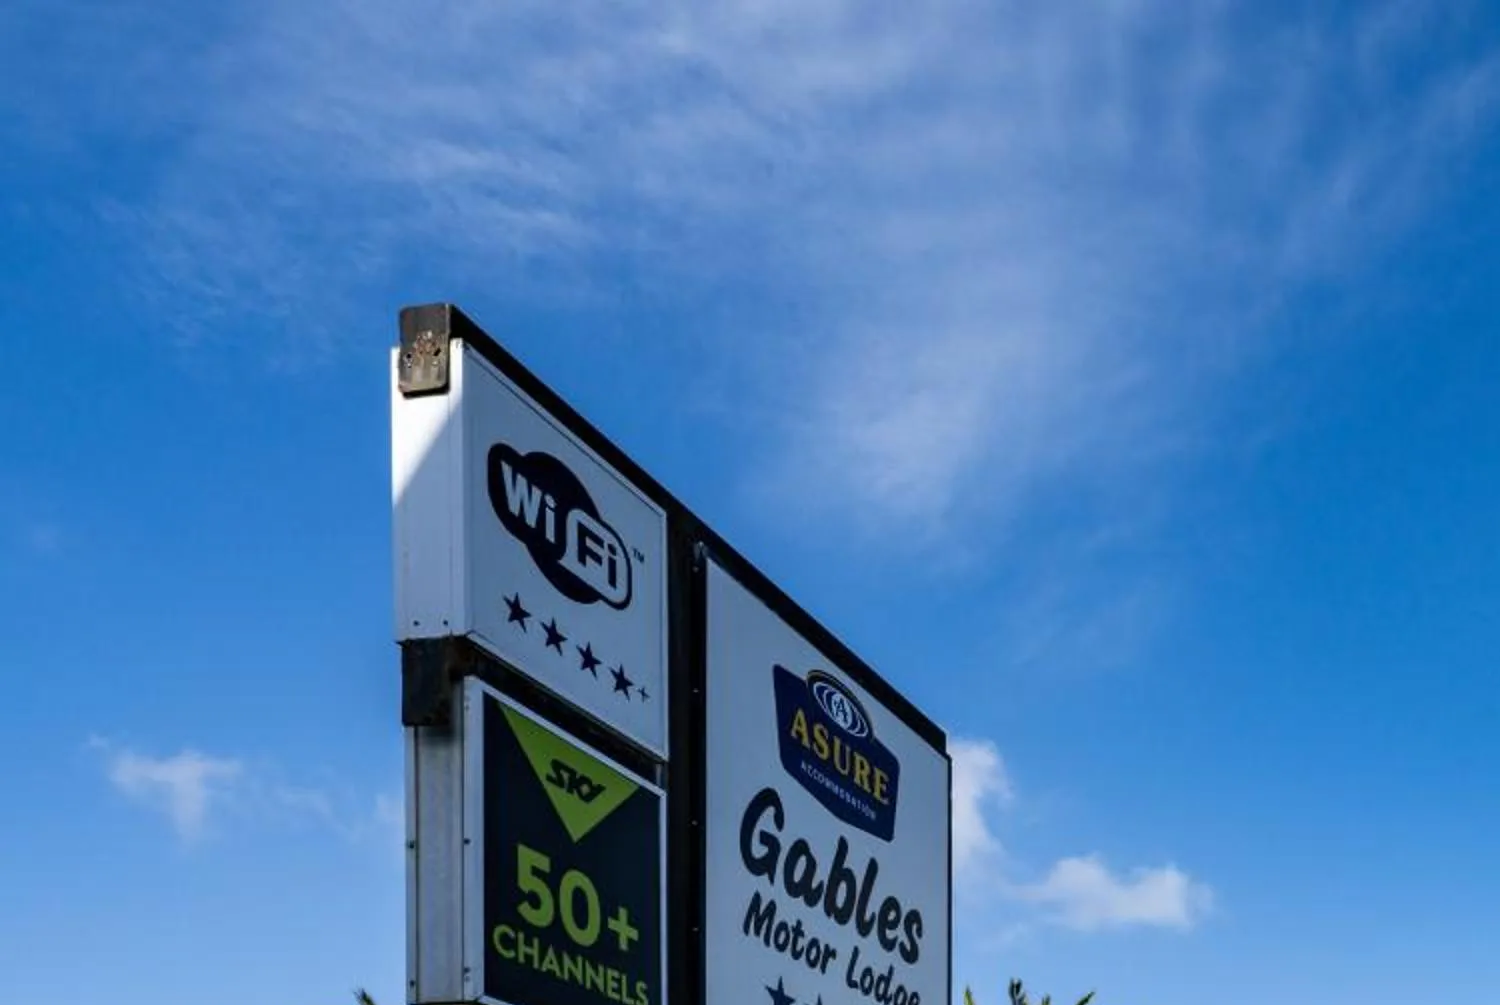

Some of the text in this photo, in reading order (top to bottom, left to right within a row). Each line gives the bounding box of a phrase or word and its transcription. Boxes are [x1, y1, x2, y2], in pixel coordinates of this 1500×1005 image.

[790, 707, 890, 805] ASURE
[800, 760, 877, 821] ACCOMMODATION
[517, 842, 640, 952] 50+
[740, 787, 924, 965] Gables
[743, 889, 838, 975] Motor
